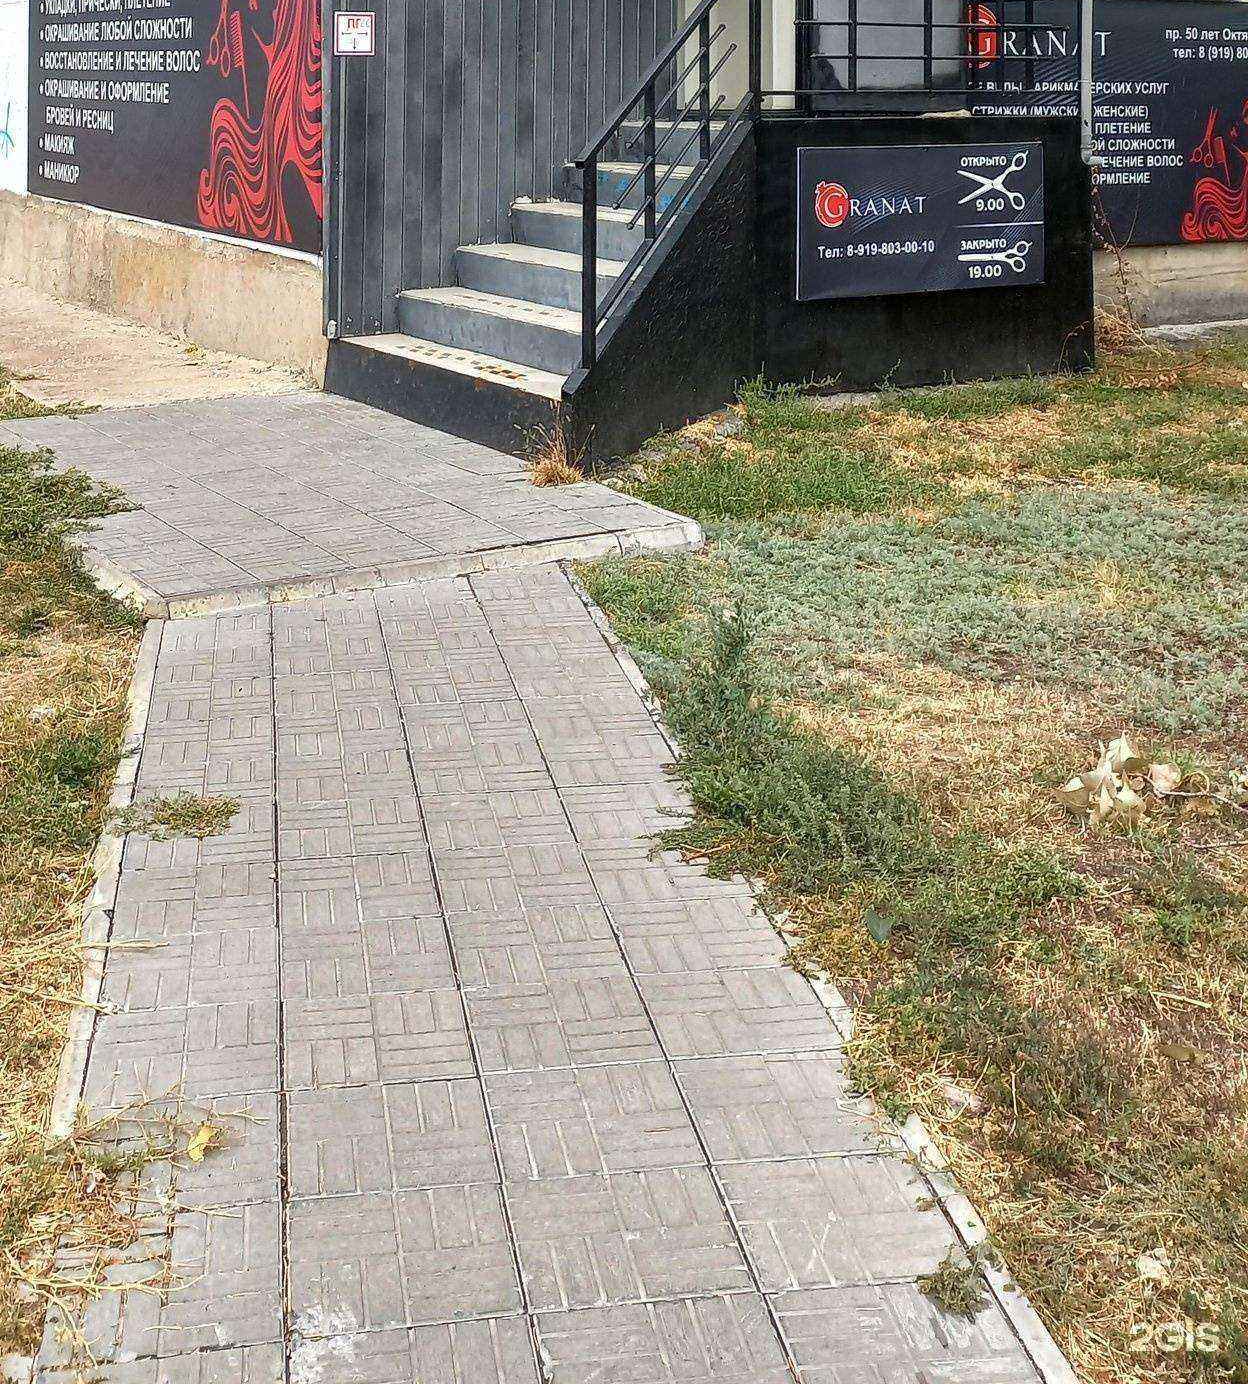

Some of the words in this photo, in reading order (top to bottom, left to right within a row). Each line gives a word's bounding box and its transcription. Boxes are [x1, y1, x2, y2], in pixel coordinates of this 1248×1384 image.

[45, 22, 99, 41] ОКРАШИВАНИЕ
[100, 15, 133, 41] ЛЮБОЙ
[134, 17, 192, 40] СЛОЖНОСТИ
[1165, 29, 1182, 41] пр.
[1186, 27, 1198, 40] 50
[1200, 30, 1220, 40] лет
[1173, 48, 1195, 59] тел:
[1199, 46, 1205, 59] 8
[1208, 46, 1234, 62] (919)
[45, 51, 113, 71] ВОССТАНОВЛЕНИЕ
[115, 51, 122, 71] И
[123, 51, 164, 72] ЛЕЧЕНИЕ
[166, 50, 200, 73] ВОЛОС
[44, 79, 99, 100] ОКРАШИВАНИЕ
[100, 82, 107, 100] И
[108, 82, 170, 104] ОФОРМЛЕНИЕ
[1134, 82, 1169, 95] УСЛУГ
[46, 104, 74, 126] БРОВЕЙ
[75, 108, 81, 127] И
[82, 109, 114, 134] РЕСНИЦ
[1093, 105, 1149, 119] ЖЕНСКИЕ)
[1095, 122, 1151, 134] ПЛЕТЕНИЕ
[1108, 138, 1175, 151] СЛОЖНОСТИ
[960, 156, 1007, 167] ОТКРЫТО
[1101, 156, 1144, 167] ЕЧЕНИЕ
[1146, 155, 1184, 167] ВОЛОС
[1091, 172, 1151, 184] ОРМЛЕНИЕ
[825, 193, 927, 217] GRANAT
[976, 197, 1005, 212] 9.00
[818, 245, 844, 259] Тел:
[847, 240, 935, 257] 8-919-803-00-10
[960, 238, 1007, 250] ЗАКРЫТО
[968, 264, 1002, 278] 19.00
